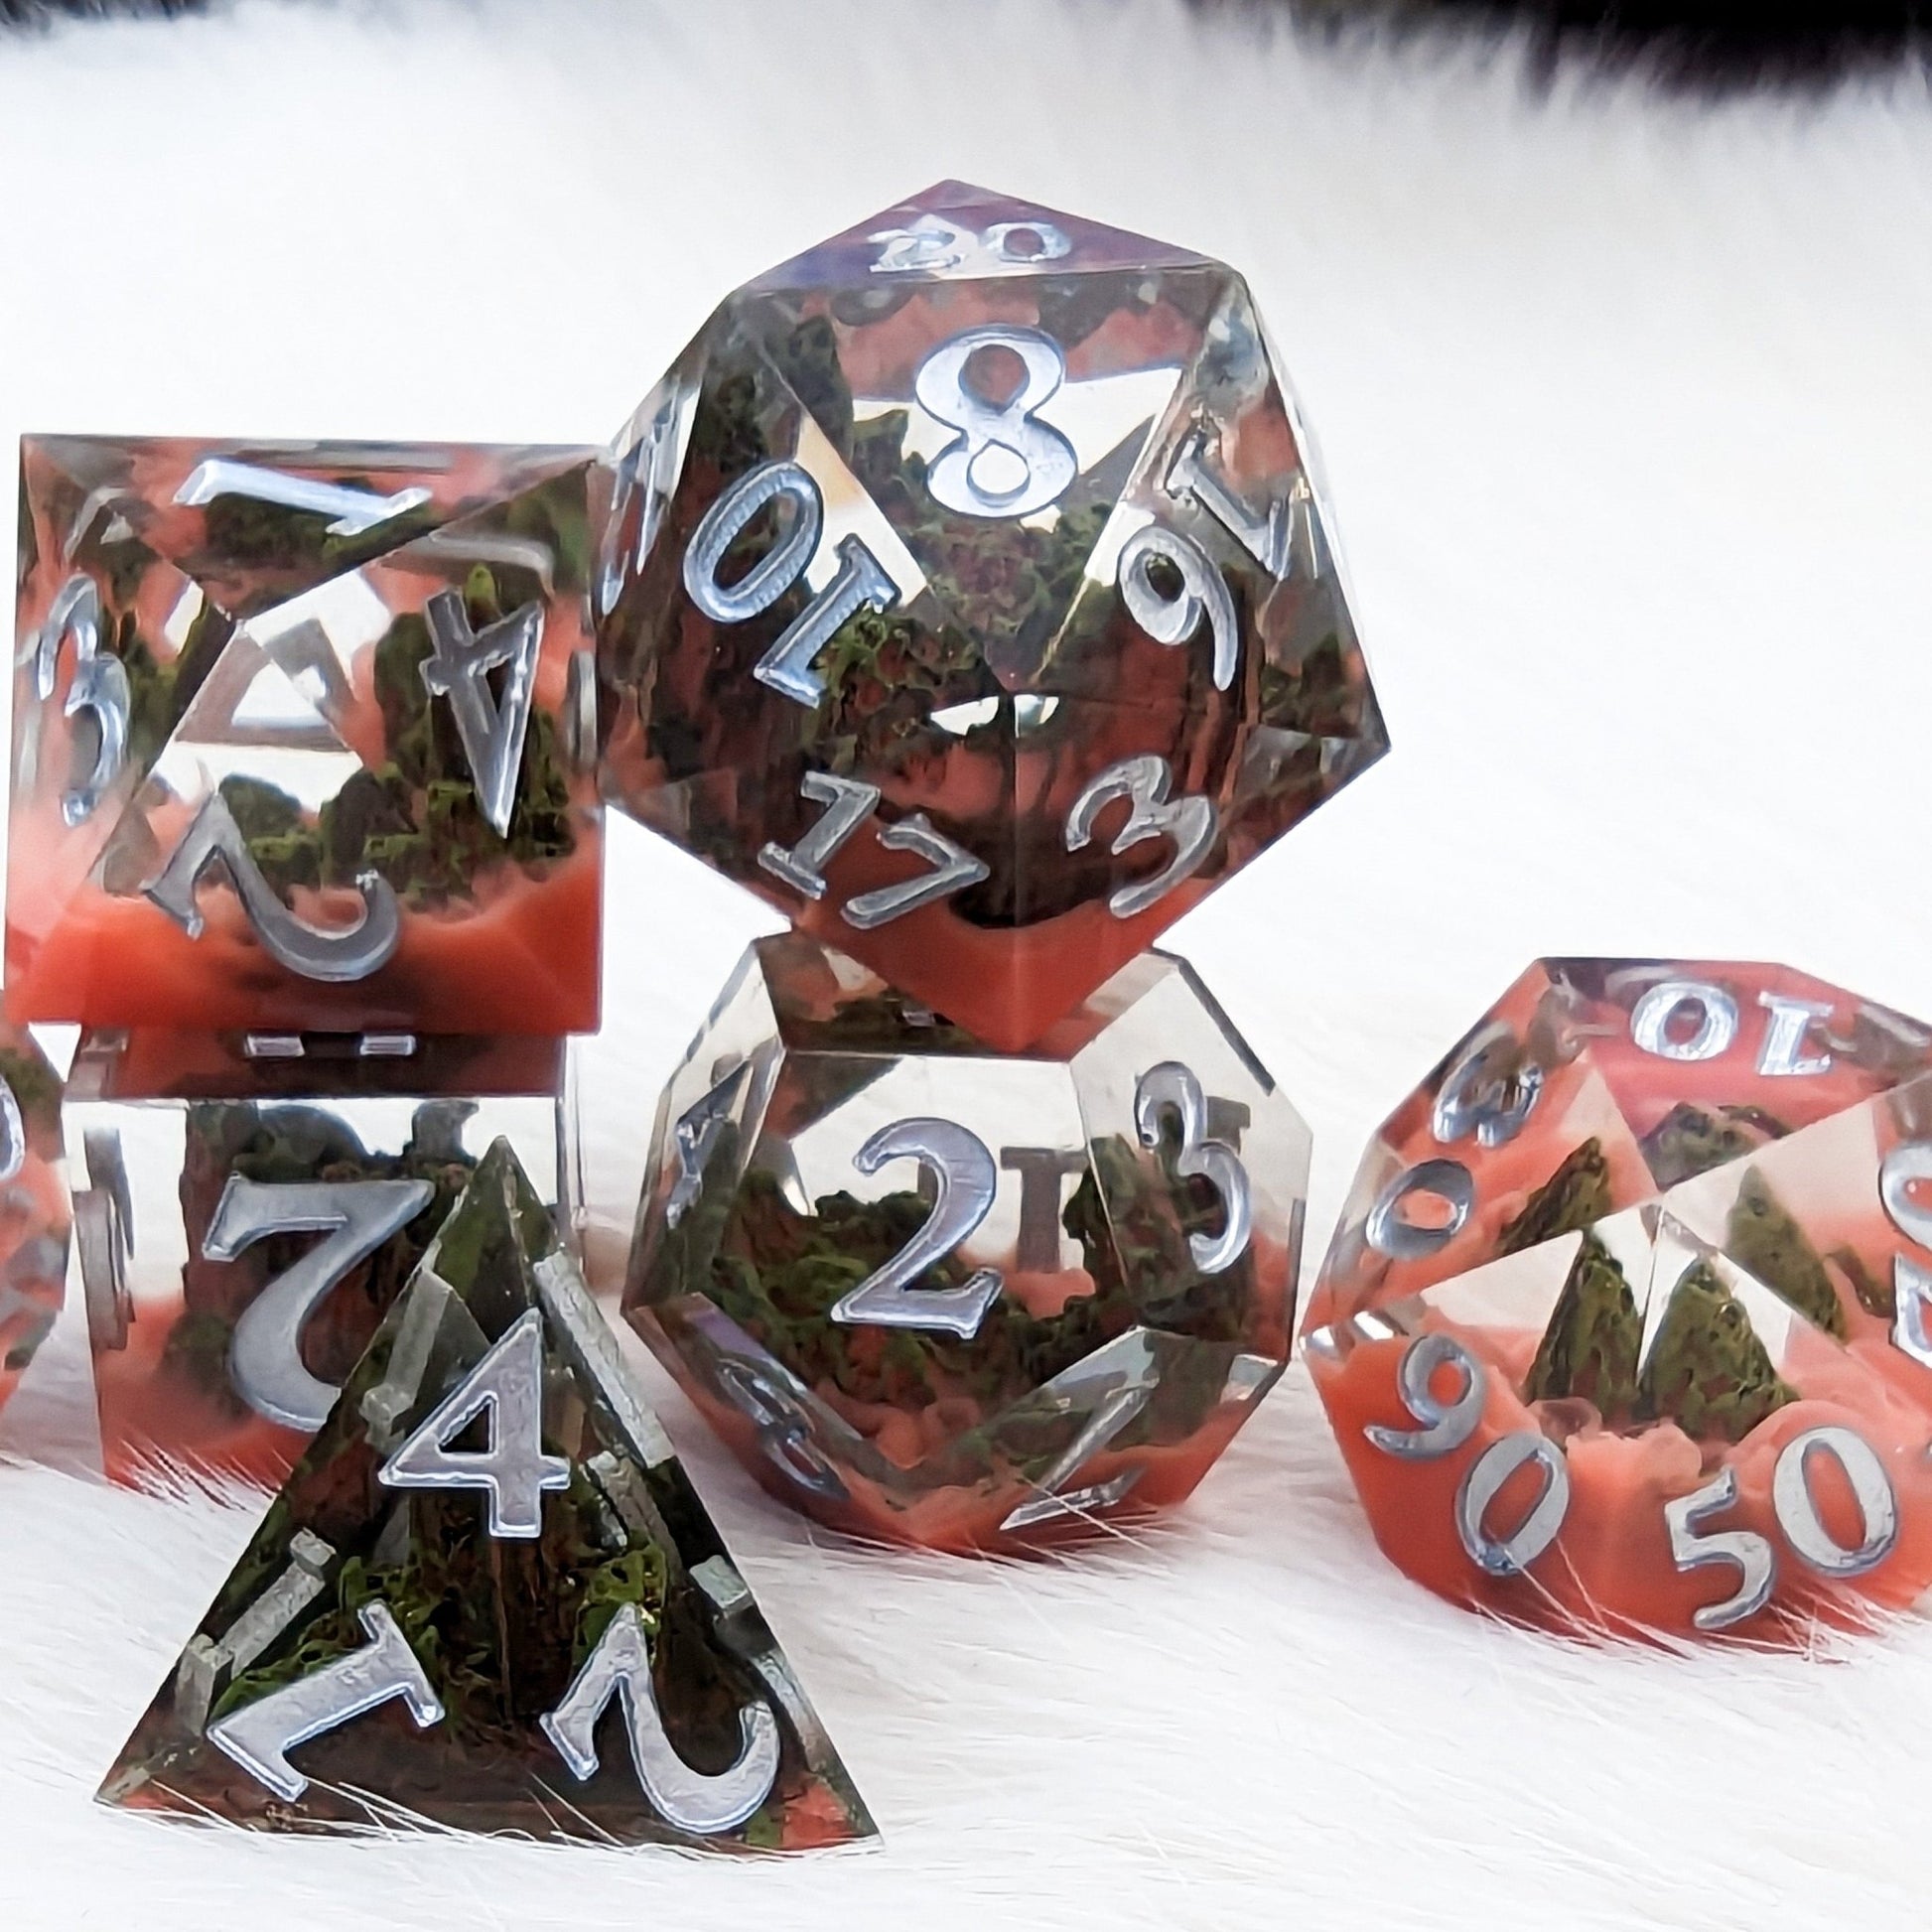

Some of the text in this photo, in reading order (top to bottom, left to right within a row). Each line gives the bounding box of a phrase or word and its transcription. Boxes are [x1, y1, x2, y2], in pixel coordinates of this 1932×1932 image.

[867, 214, 1072, 273] 20
[914, 325, 1080, 518] 8
[419, 584, 545, 839] 4
[138, 789, 404, 983] 2
[1065, 756, 1217, 919] 3
[830, 1116, 1006, 1339] 2
[1134, 1060, 1251, 1275] 3
[378, 1307, 572, 1538] 4
[1663, 1424, 1901, 1630] 50
[207, 1599, 445, 1803] 1
[539, 1602, 781, 1834] 2
